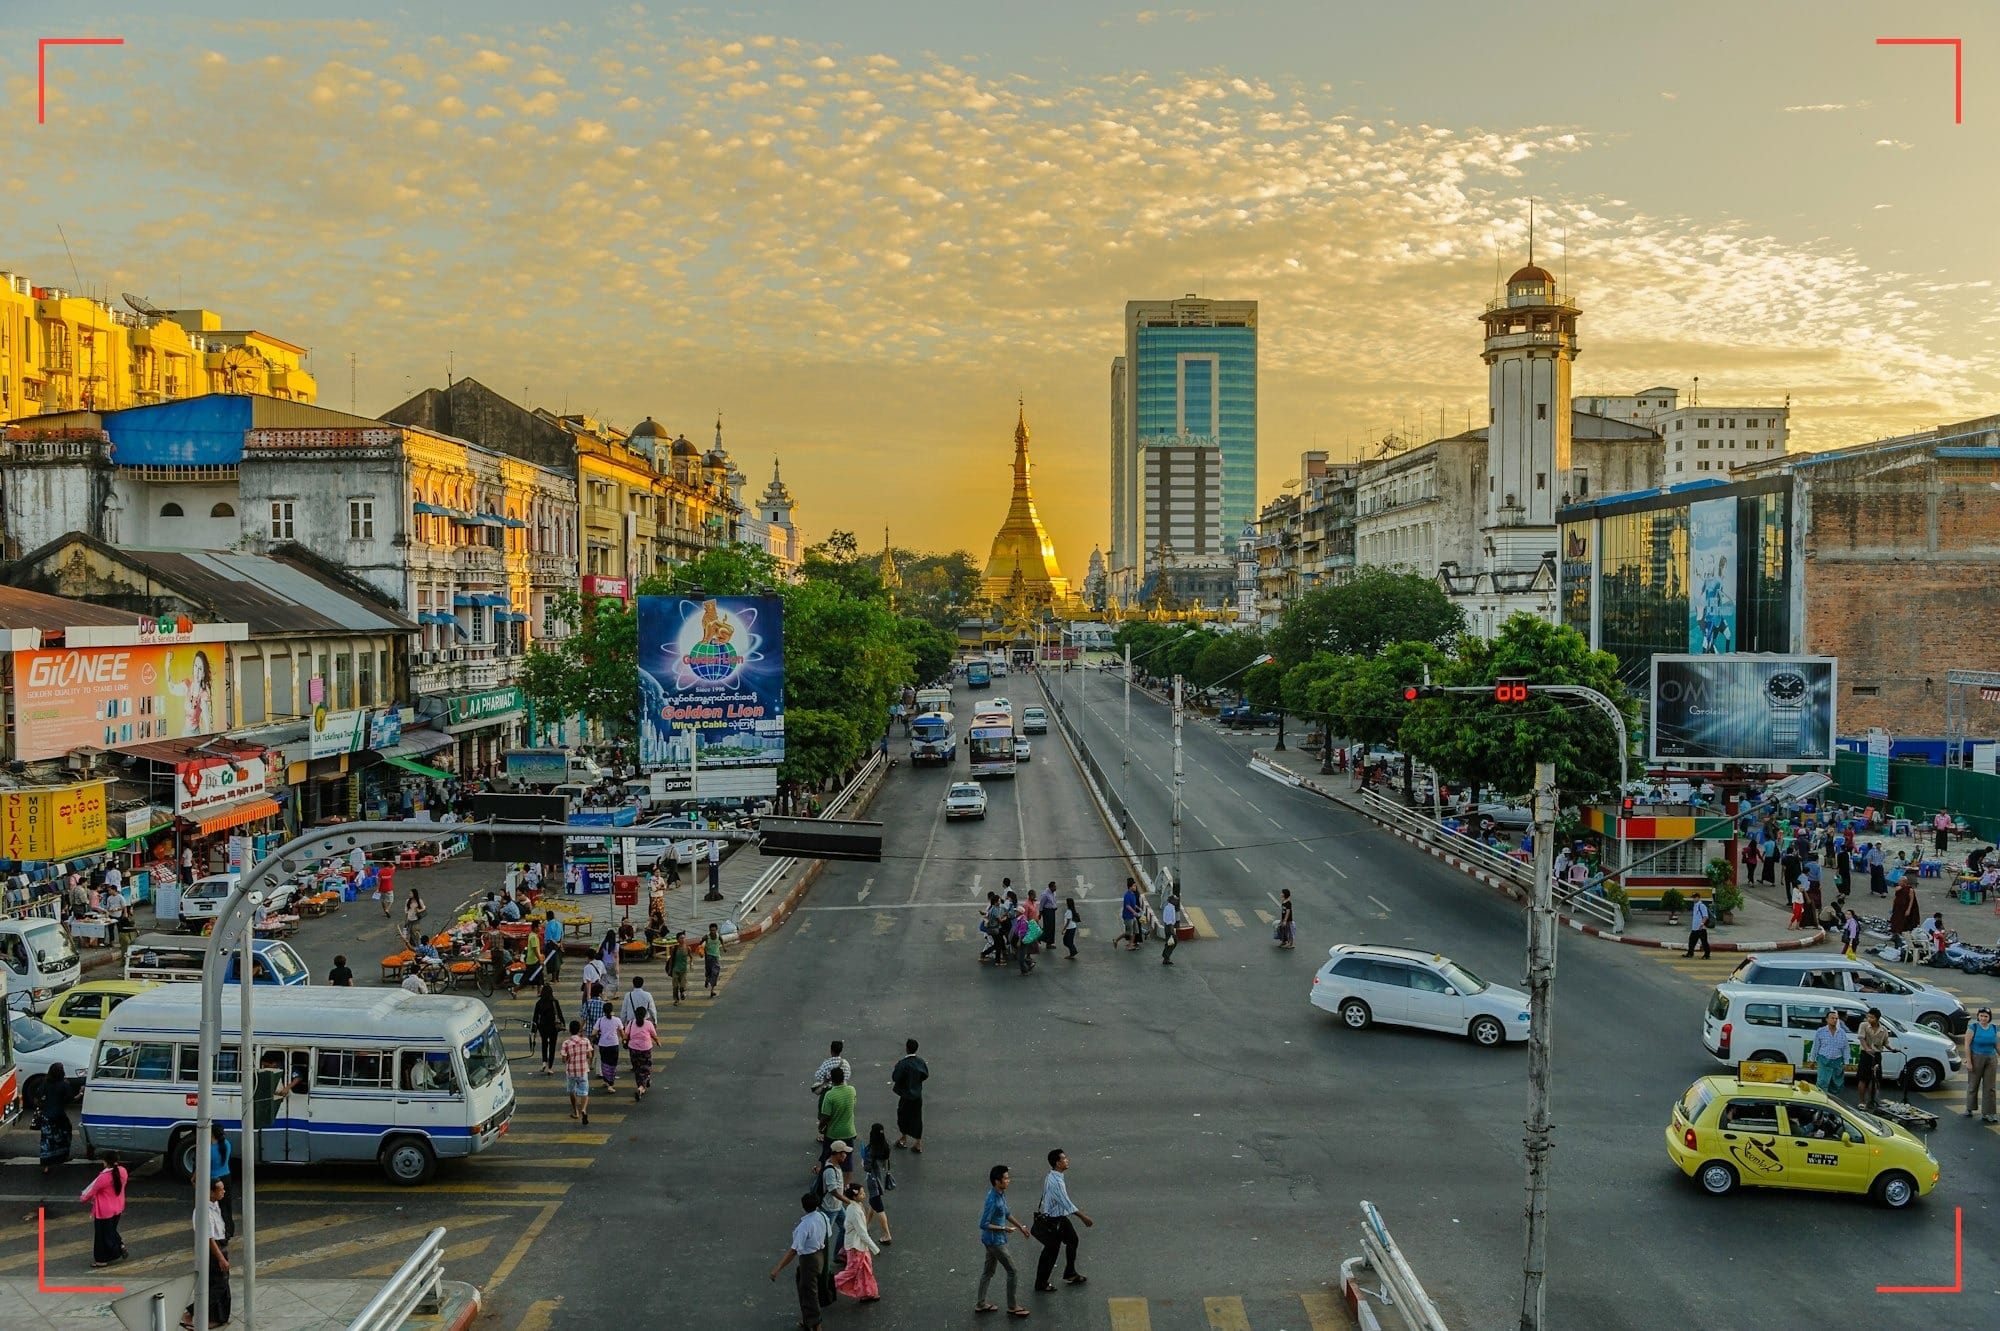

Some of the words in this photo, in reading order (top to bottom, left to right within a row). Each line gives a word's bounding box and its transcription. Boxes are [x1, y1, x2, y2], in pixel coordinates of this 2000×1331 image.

[1185, 435, 1217, 445] BANK
[158, 615, 175, 634] Co
[157, 635, 175, 643] Service
[683, 654, 718, 665] Golden
[27, 690, 53, 699] GOLDEN
[55, 688, 80, 696] QUALITY
[93, 685, 113, 693] STAND
[482, 691, 516, 712] PHARMACY
[661, 705, 723, 720] Golden
[727, 704, 765, 718] Lion
[672, 721, 694, 729] Wire
[694, 720, 701, 729] &
[702, 720, 727, 728] Cable
[222, 770, 233, 785] Co
[9, 793, 22, 859] SULAY
[28, 796, 38, 853] MOBILE
